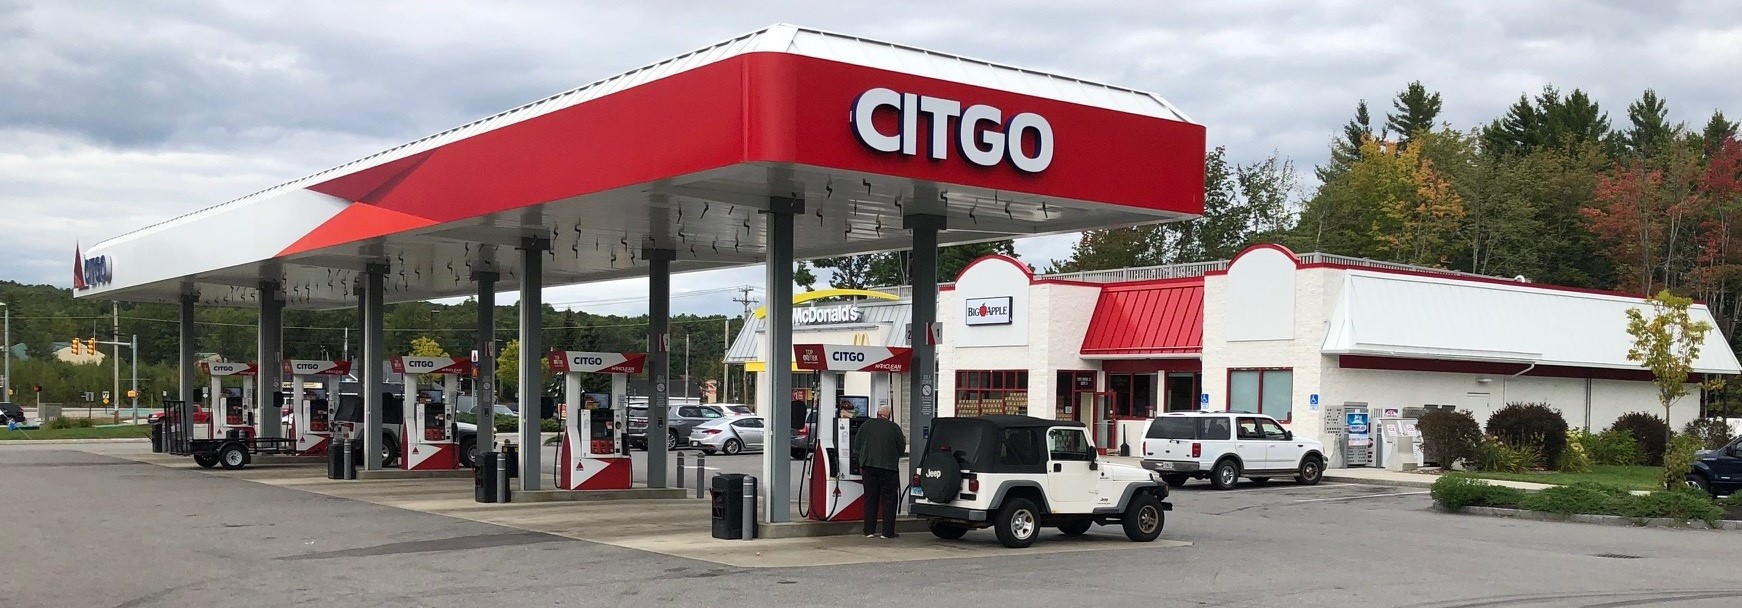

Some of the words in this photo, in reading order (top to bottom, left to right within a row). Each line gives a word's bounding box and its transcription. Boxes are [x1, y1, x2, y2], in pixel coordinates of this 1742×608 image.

[853, 87, 1054, 173] CITGO
[793, 305, 860, 324] McDonald's
[987, 306, 1008, 316] APPLE
[936, 328, 940, 338] 1
[573, 356, 602, 365] CITGO
[832, 351, 865, 362] CITGO
[408, 360, 434, 368] CITGO
[925, 468, 942, 479] Jeep
